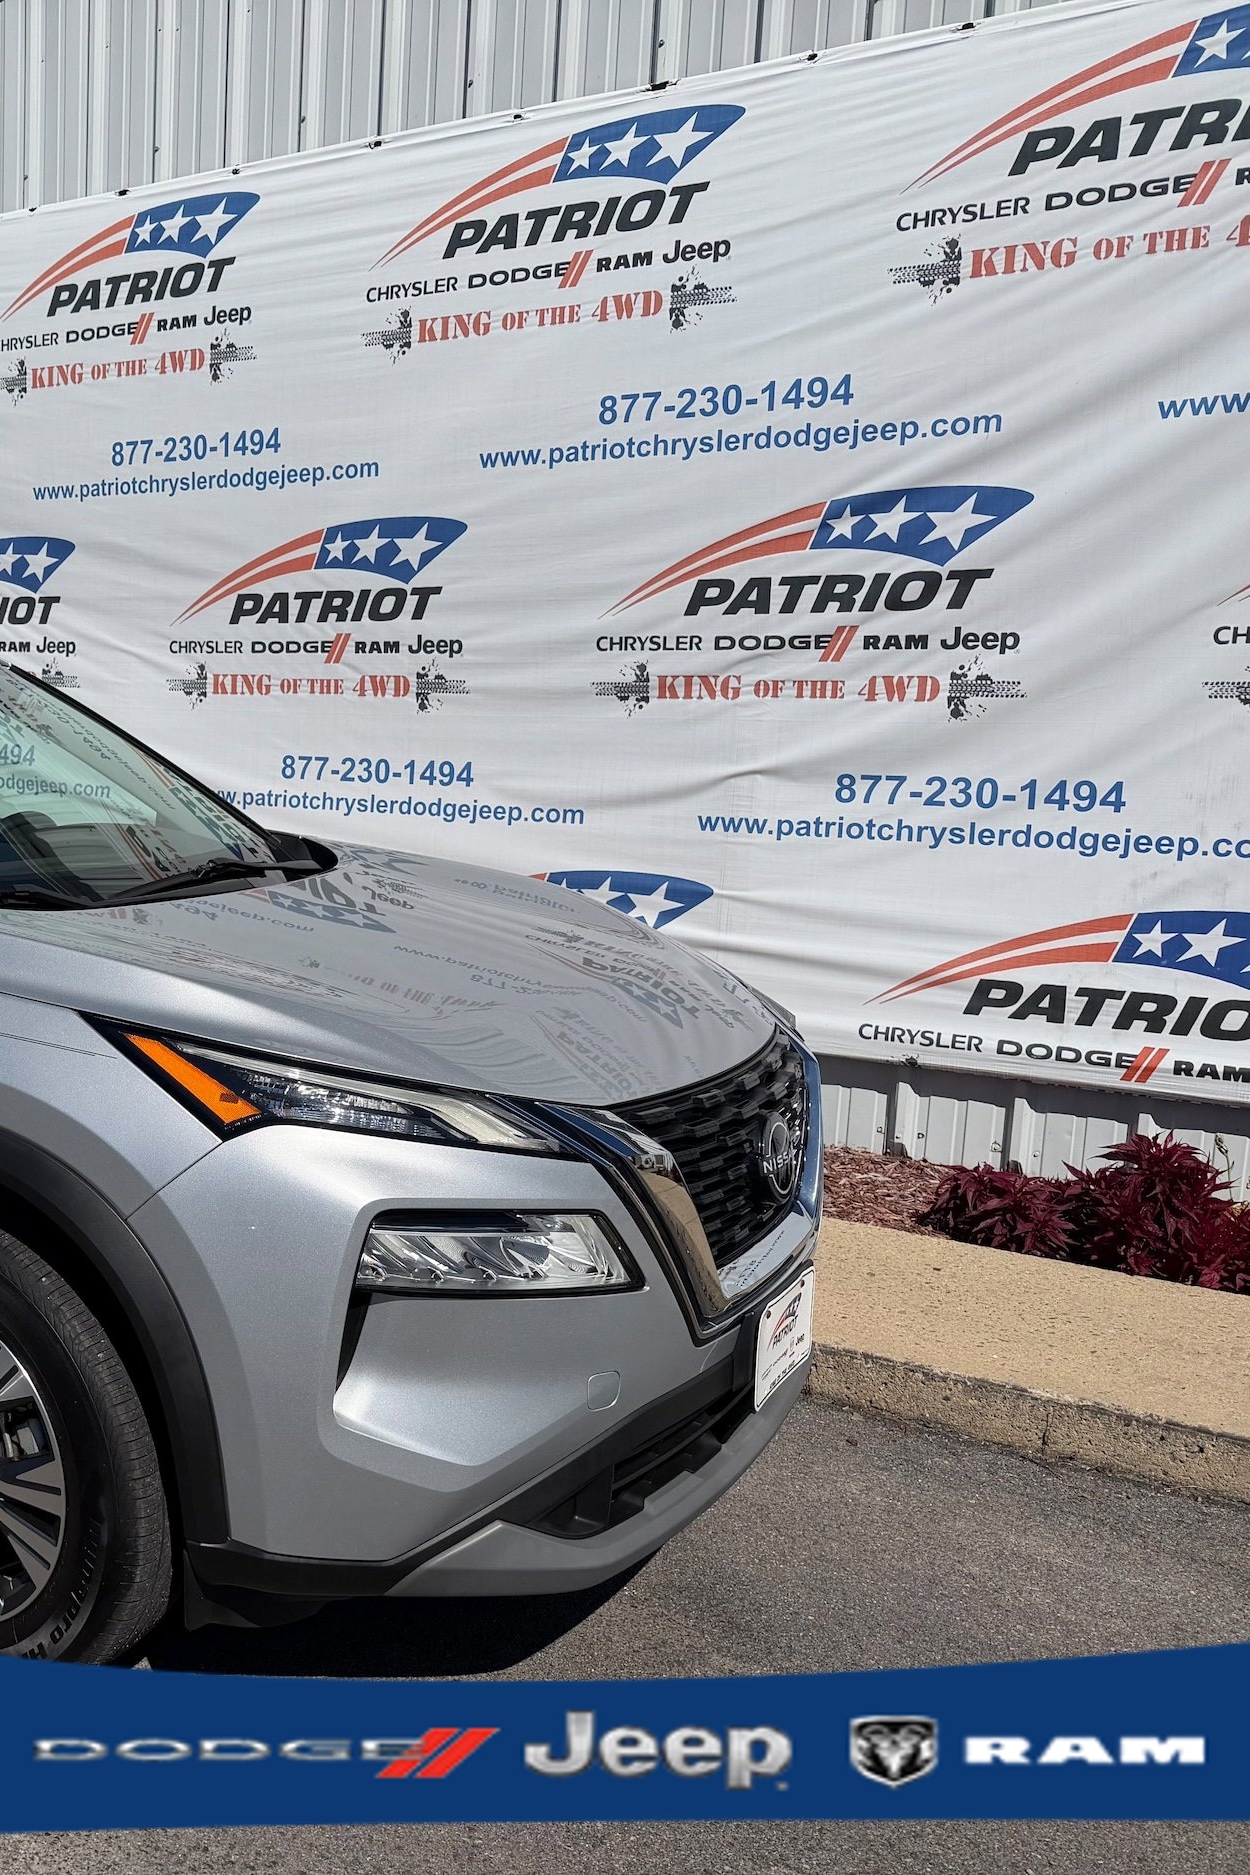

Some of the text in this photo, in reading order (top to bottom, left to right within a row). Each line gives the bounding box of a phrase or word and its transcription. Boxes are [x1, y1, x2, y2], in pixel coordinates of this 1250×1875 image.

[442, 181, 710, 260] PATRIOT
[896, 196, 1031, 232] CHRYSLER
[1044, 172, 1199, 212] DODGE
[366, 239, 731, 303] CHRYSLER DODGE RAM Jeep
[968, 237, 1079, 280] KING
[1092, 235, 1133, 262] OF
[1144, 225, 1210, 256] THE
[47, 256, 236, 318] PATRIOT
[65, 321, 140, 346] DODGE
[156, 314, 197, 332] RAM
[203, 305, 252, 326] Jeep
[416, 290, 663, 345] KING OF THE 4WD
[30, 348, 206, 390] KING OF THE 4WD
[599, 380, 854, 425] 877-230-1494
[111, 427, 282, 467] 877-230-1494
[479, 414, 1003, 470] www.patriotchryslerdodgejeep.com
[35, 462, 379, 500] www.patriotchryslerdodgejeep.com
[229, 586, 443, 625] PATRIOT
[684, 569, 995, 616] PATRIOT
[35, 636, 76, 658] Jeep
[169, 633, 463, 659] CHRYSLER DODGE RAM Jeep
[595, 626, 1021, 655] CHRYSLER DODGE RAM Jeep
[211, 672, 410, 697] KING OF THE 4WD
[656, 673, 940, 703] KING OF THE 4WD
[281, 754, 474, 787] 877-230-1494
[834, 773, 1127, 814] 877-230-1494
[858, 1023, 1250, 1084] CHRYSLER DODGE RAM
